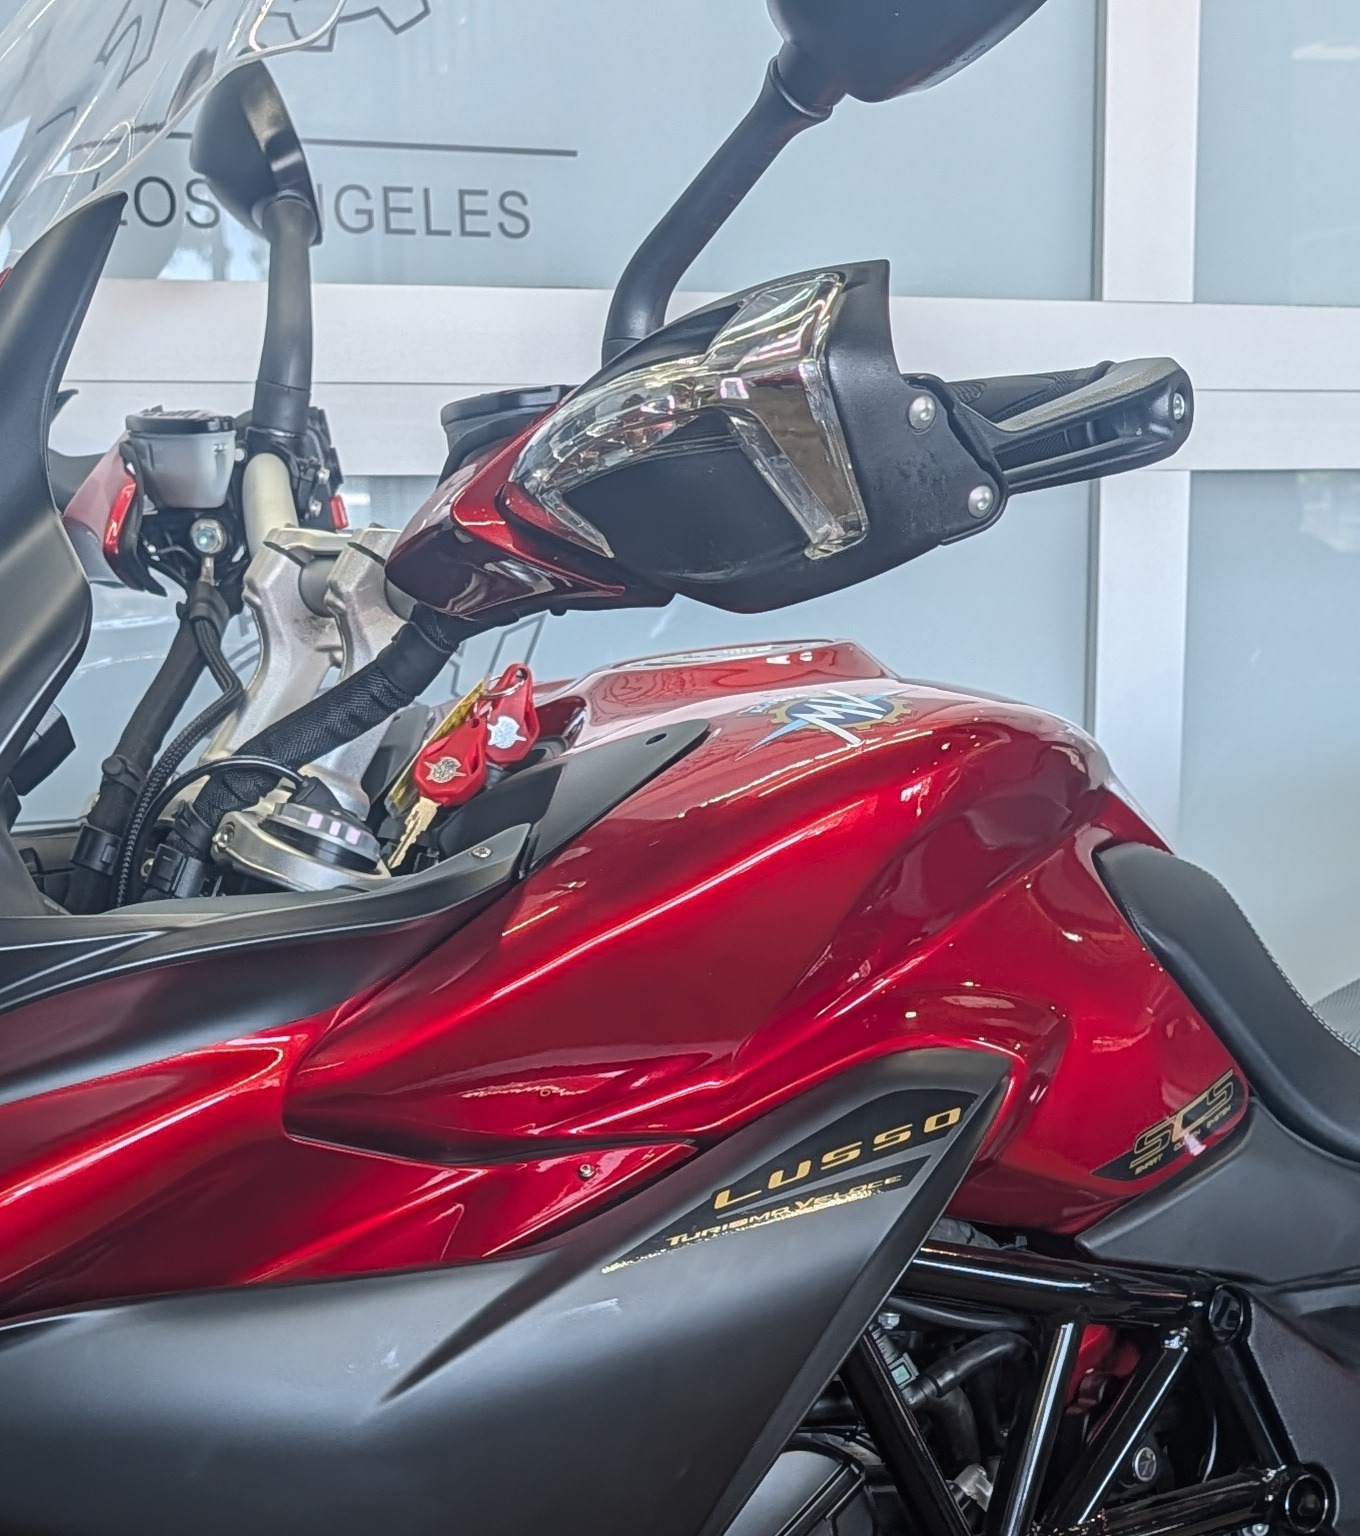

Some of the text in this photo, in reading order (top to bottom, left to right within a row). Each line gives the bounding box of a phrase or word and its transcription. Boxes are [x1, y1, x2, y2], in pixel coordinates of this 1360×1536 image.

[316, 183, 531, 240] GELES
[713, 1106, 962, 1211] LUSSO
[1129, 1068, 1234, 1170] SCS
